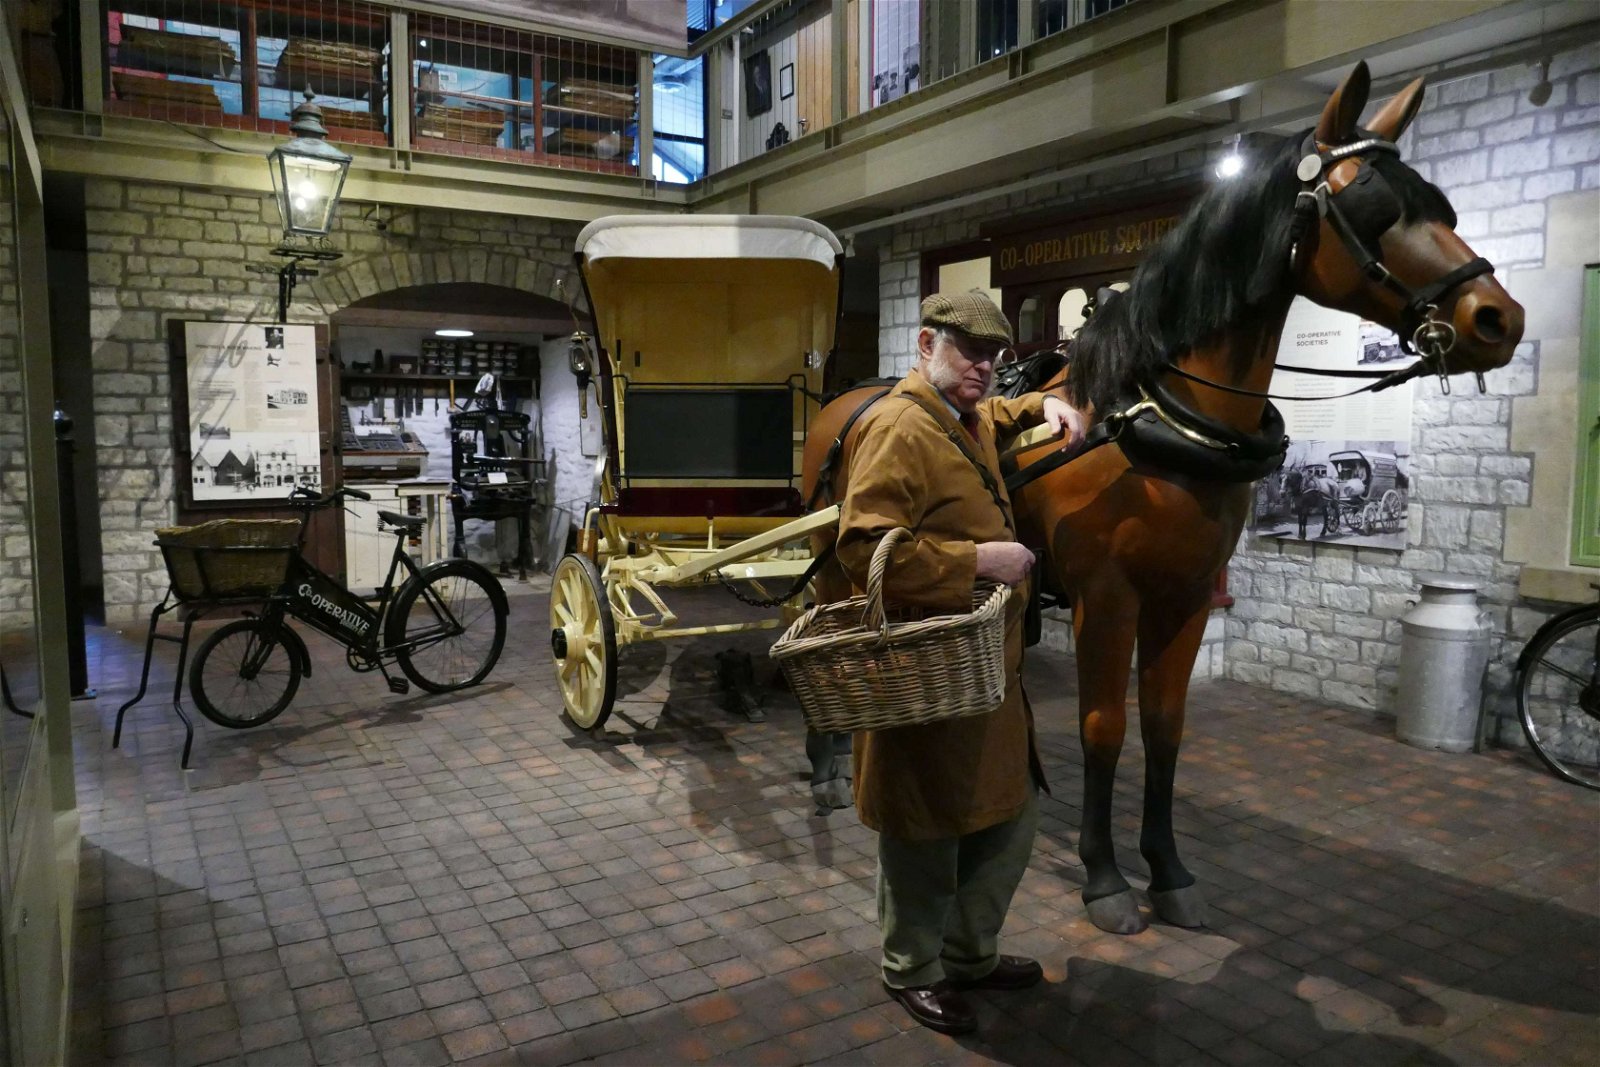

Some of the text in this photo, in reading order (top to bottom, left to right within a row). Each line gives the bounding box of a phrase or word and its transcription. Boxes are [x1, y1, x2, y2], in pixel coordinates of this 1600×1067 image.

[1000, 231, 1110, 271] CO-OPERATIVE
[1296, 330, 1342, 339] CO-OPERATIVE
[1296, 339, 1329, 347] SOCIETIES
